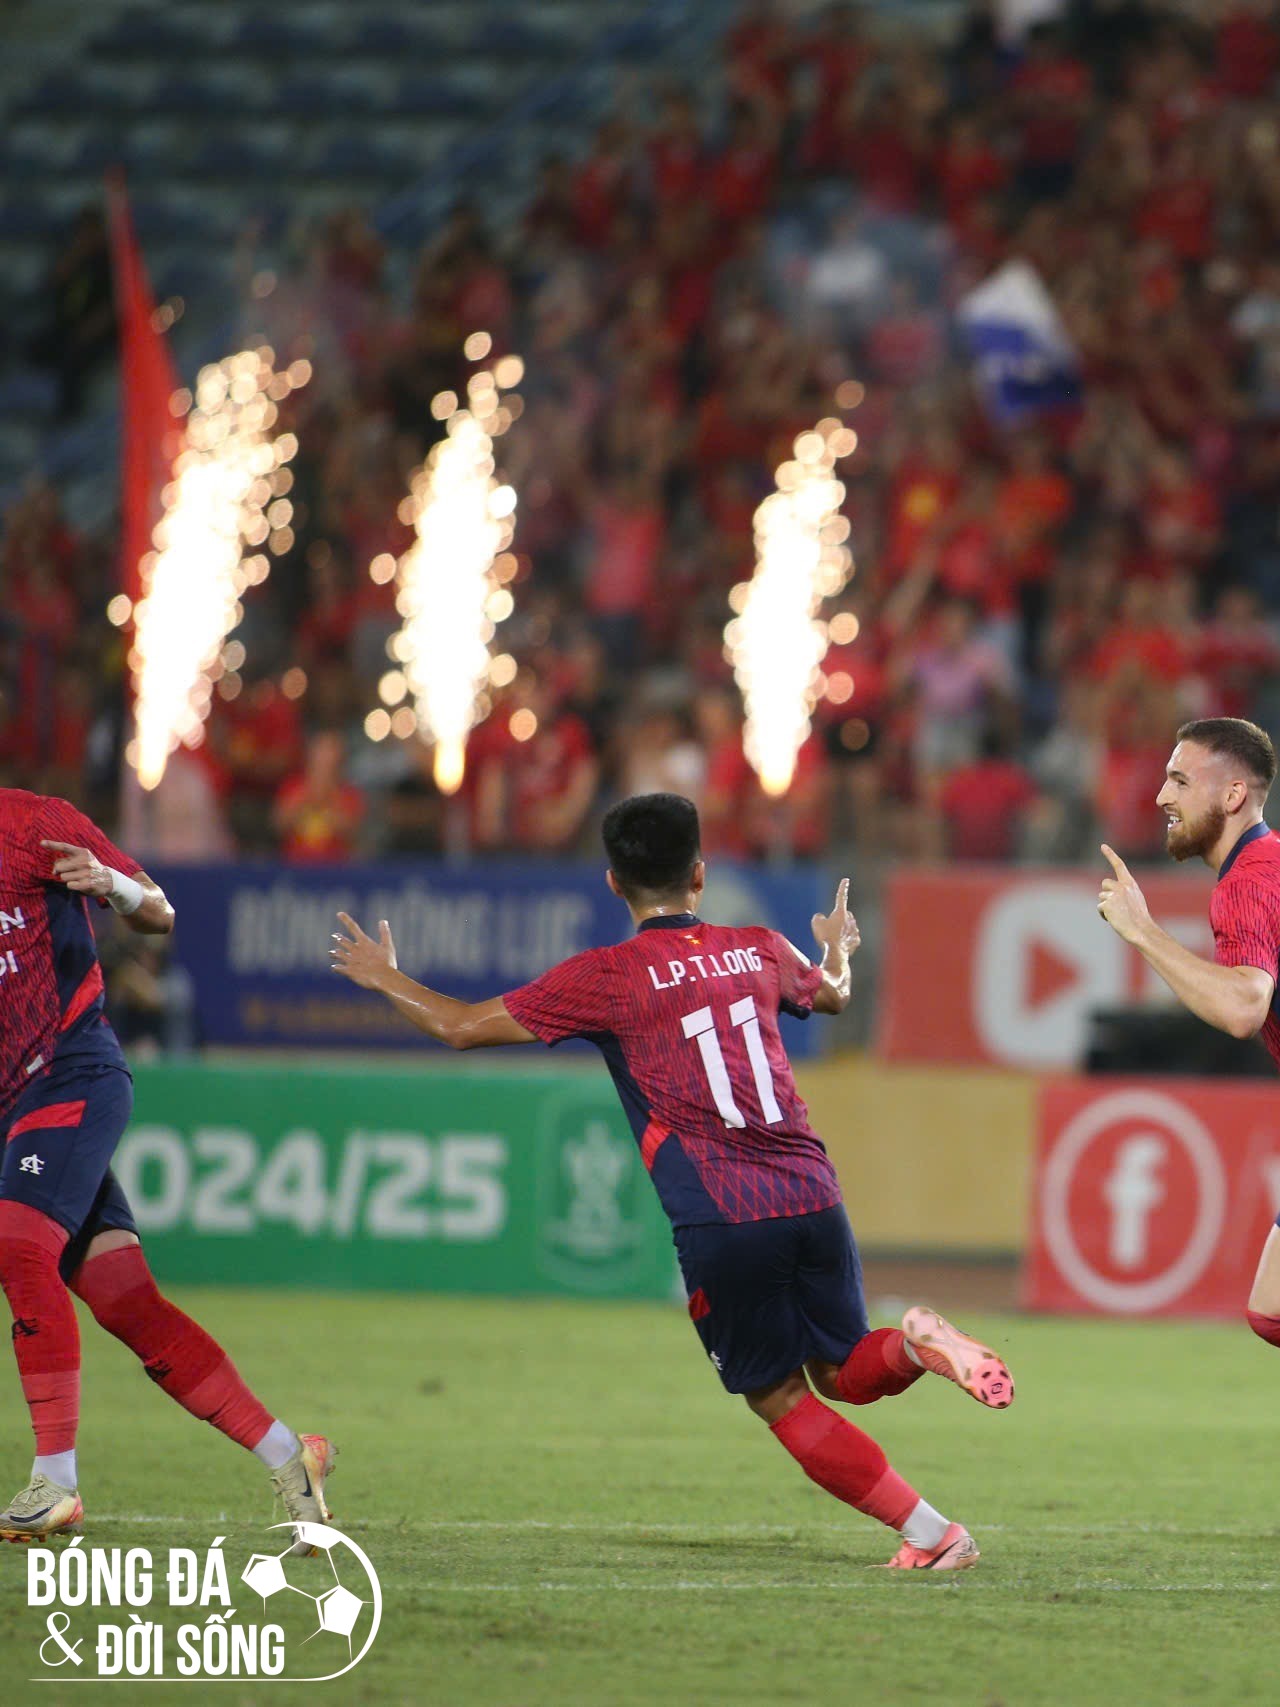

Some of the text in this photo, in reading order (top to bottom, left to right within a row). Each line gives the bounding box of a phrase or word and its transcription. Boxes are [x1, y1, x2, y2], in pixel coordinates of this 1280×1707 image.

[0, 906, 26, 936] N
[648, 946, 763, 991] L.P.T.LONG
[680, 995, 783, 1129] 11
[110, 1125, 510, 1241] 024/25
